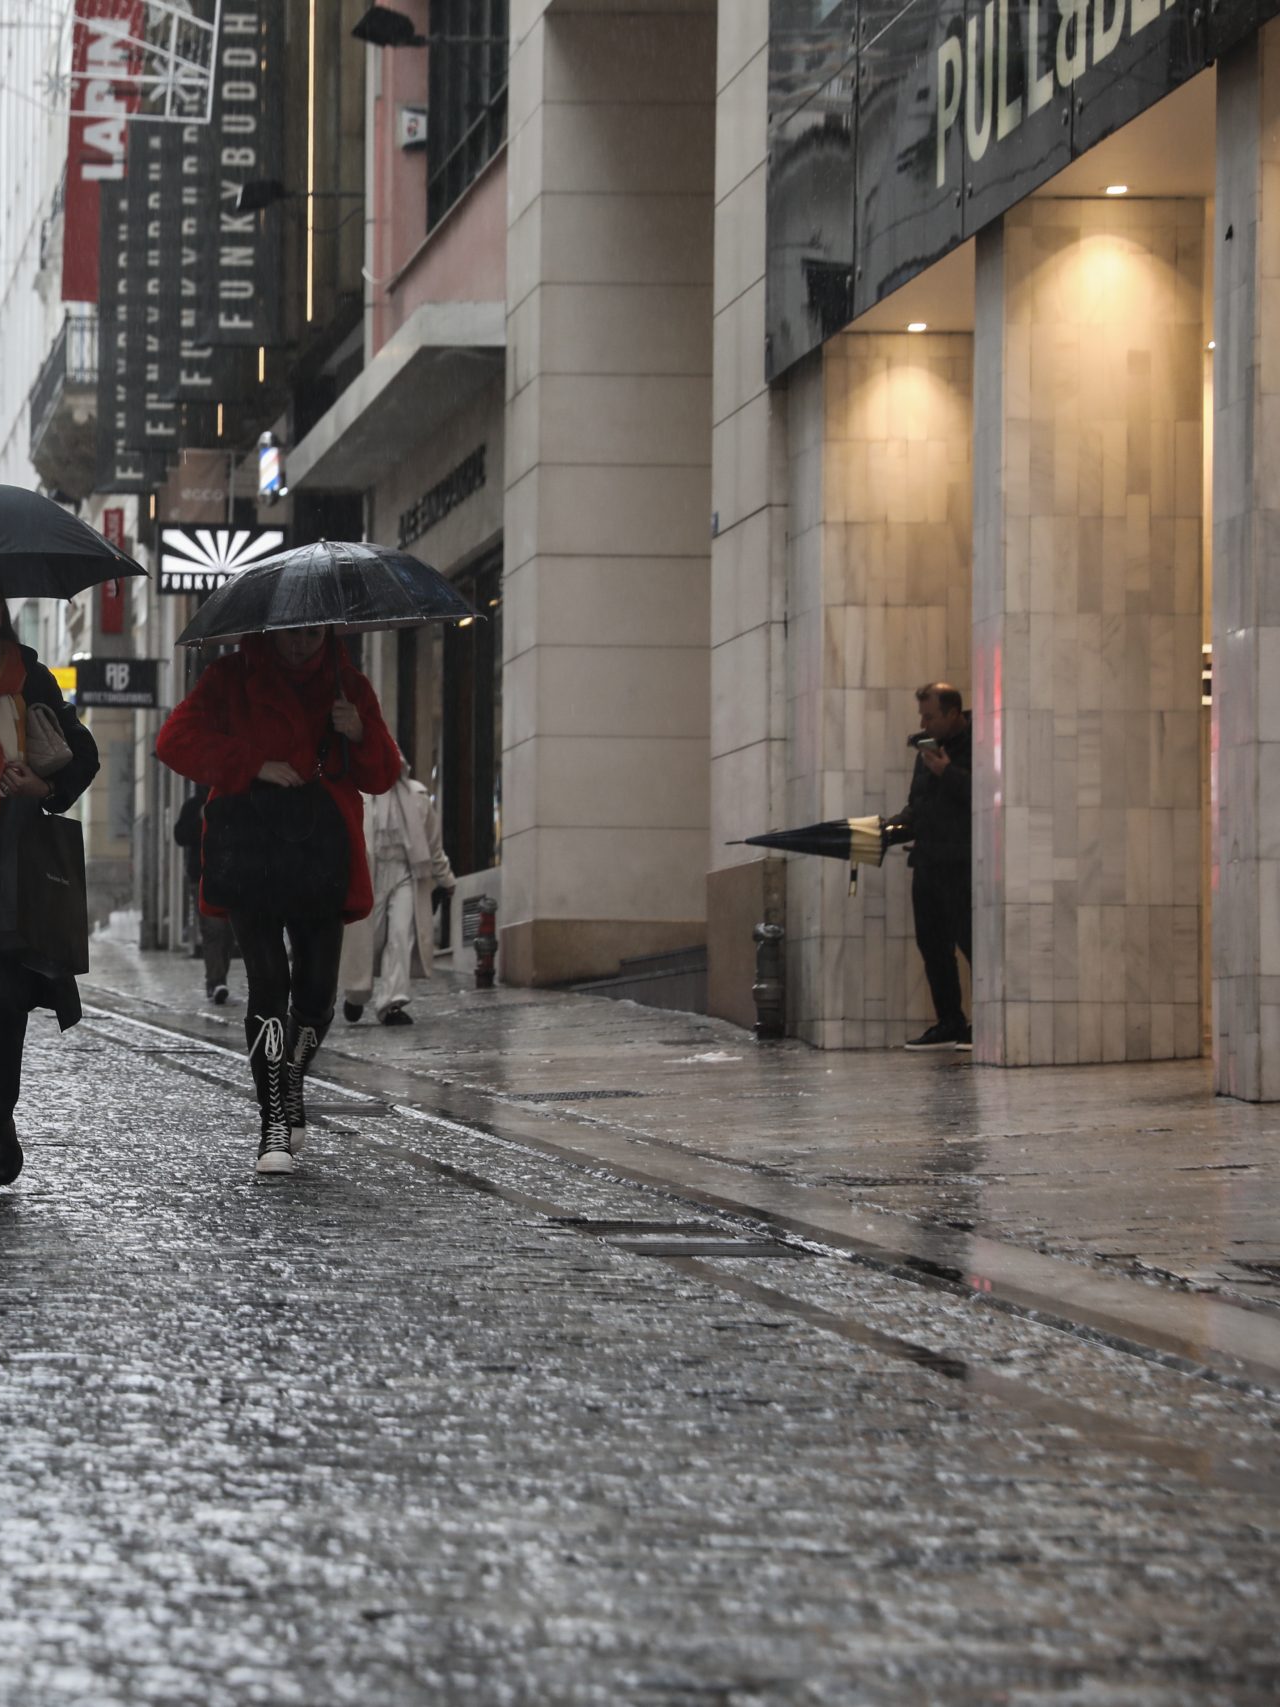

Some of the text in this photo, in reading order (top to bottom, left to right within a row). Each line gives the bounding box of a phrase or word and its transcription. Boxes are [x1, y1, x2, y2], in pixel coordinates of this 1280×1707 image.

[219, 0, 258, 329] FUNKYBUDDH
[936, 0, 1178, 189] PULL&
[161, 573, 232, 590] FUNKYB
